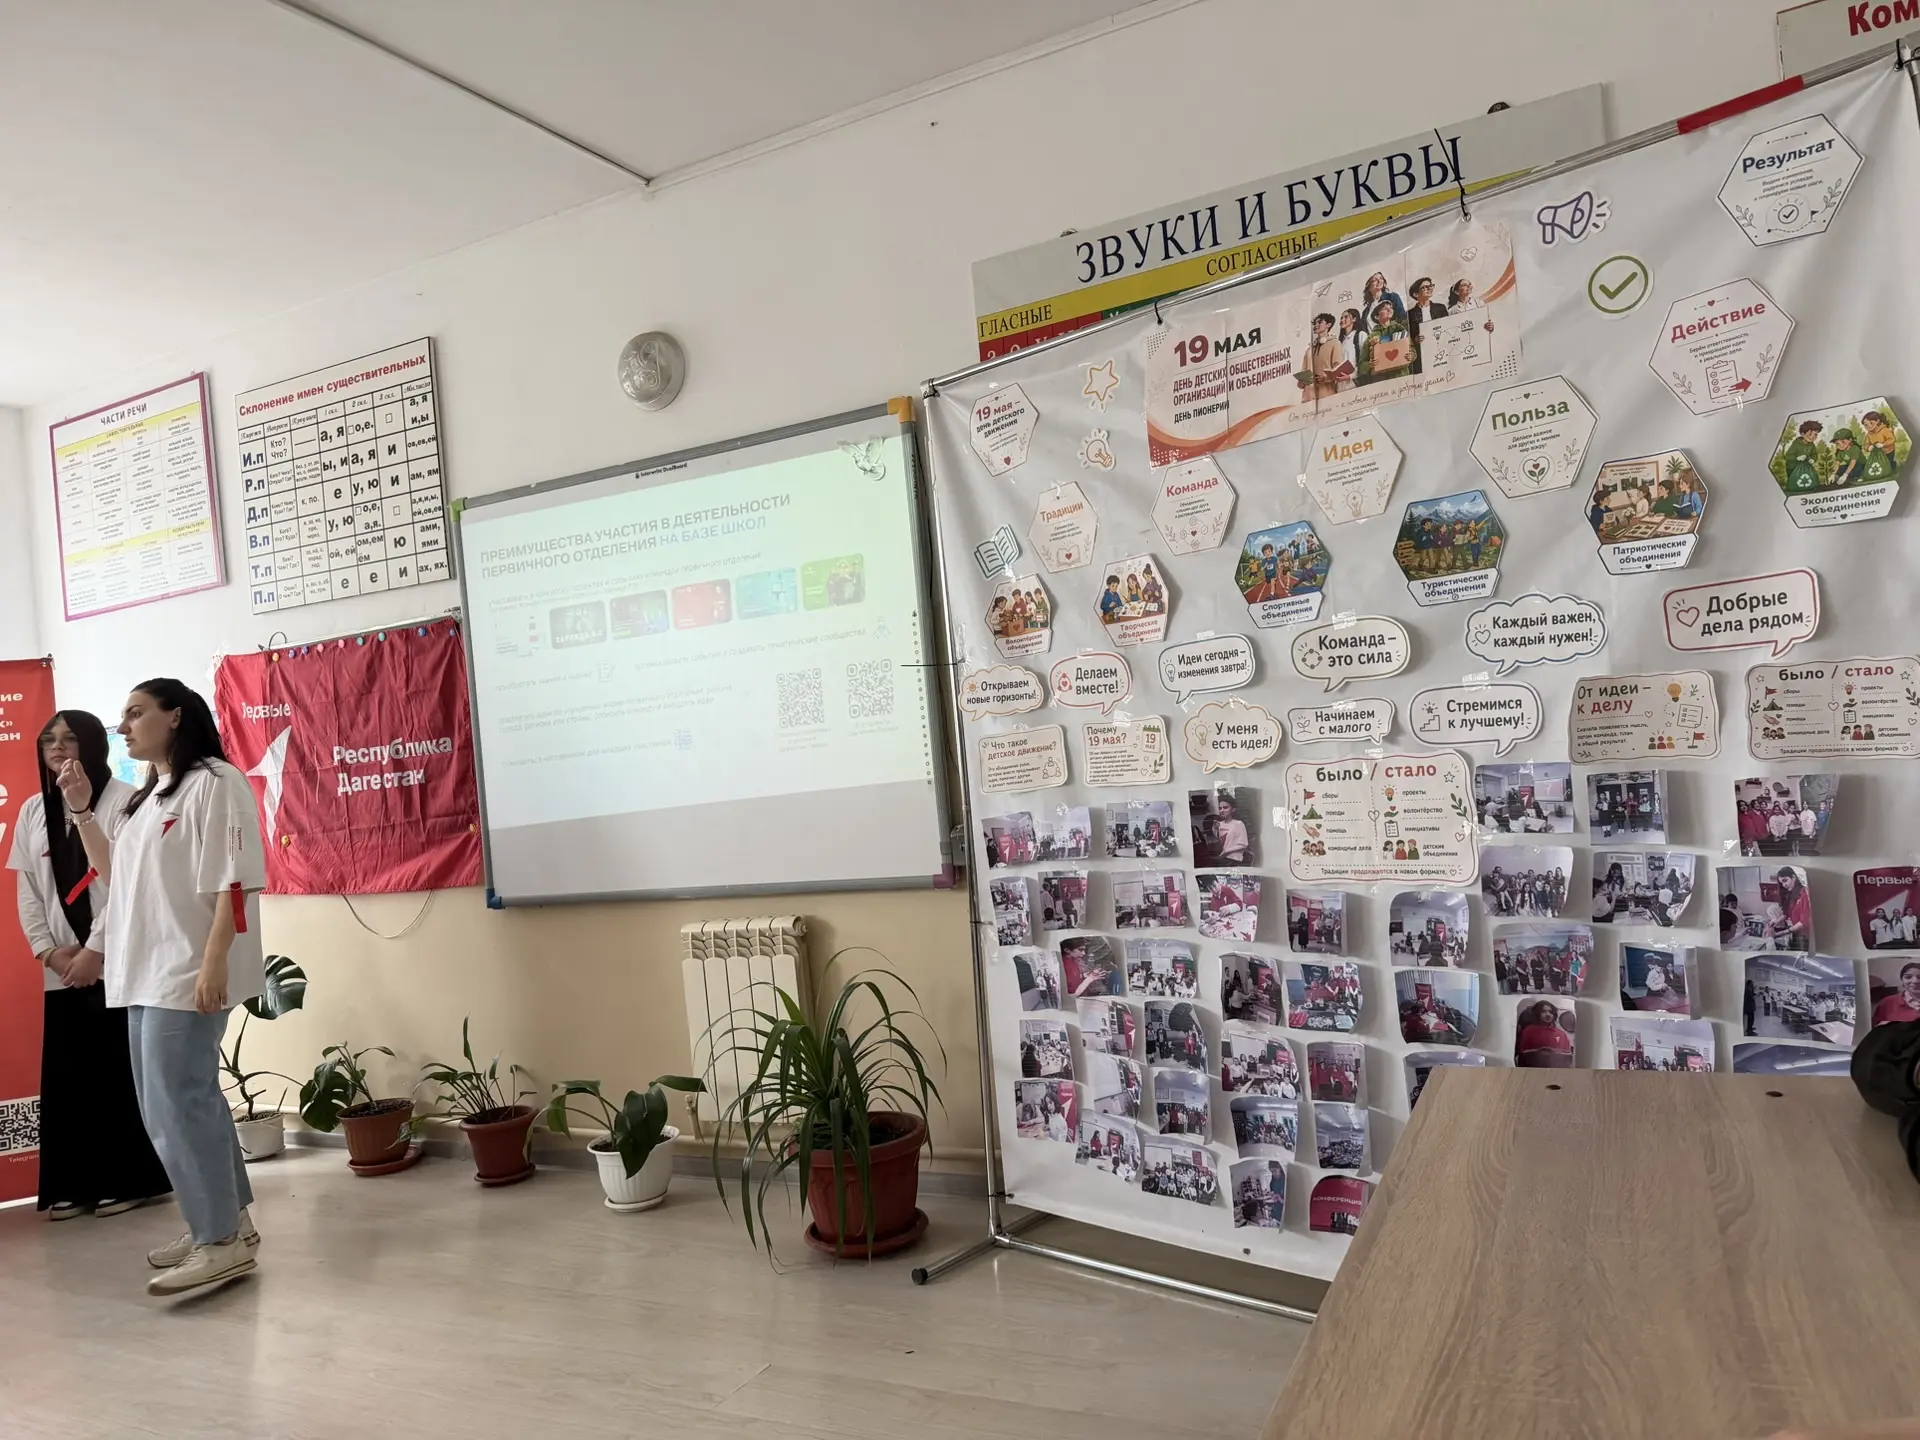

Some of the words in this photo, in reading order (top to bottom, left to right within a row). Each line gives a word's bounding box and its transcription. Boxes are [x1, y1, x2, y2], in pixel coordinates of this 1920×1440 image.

[1742, 138, 1835, 173] Результат
[1076, 211, 1222, 283] ЗВУКИ
[1238, 192, 1270, 239] И
[1286, 136, 1465, 226] БУКВЫ
[1206, 232, 1319, 277] СОГЛАСНЫЕ
[980, 304, 1053, 337] ГЛАСНЫЕ
[1671, 302, 1765, 343] Действие
[1174, 334, 1209, 367] 19
[1214, 327, 1262, 357] МАЯ
[1173, 377, 1193, 394] ДЕНЬ
[1194, 367, 1227, 389] ДЕТСКИХ
[1229, 346, 1291, 377] ОБЩЕСТВЕННЫХ
[239, 394, 294, 416] Склонение
[296, 385, 324, 400] имен
[326, 354, 426, 392] существительных
[1173, 381, 1226, 406] ОРГАНИЗАЦИЙ
[1228, 379, 1234, 392] И
[1236, 360, 1292, 390] ОБЪЕДИНЕНИЙ
[100, 411, 126, 426] ЧАСТИ
[127, 403, 148, 417] РЕЧИ
[976, 405, 991, 422] 19
[993, 401, 1012, 416] мая
[1174, 412, 1192, 424] ДЕНЬ
[1193, 402, 1230, 418] ПИОНЕРИИ
[1492, 400, 1570, 430] Польза
[976, 421, 991, 433] день
[992, 408, 1025, 427] детского
[984, 418, 1018, 439] движения
[337, 426, 345, 437] я
[270, 437, 286, 448] Кто?
[1323, 438, 1374, 462] Идея
[243, 452, 264, 467] И.п
[271, 449, 287, 459] Что?
[245, 478, 265, 493] Р.п
[334, 488, 342, 499] е
[1166, 477, 1218, 497] Команда
[1800, 486, 1886, 506] Экологические
[1040, 502, 1084, 523] Традиции
[1805, 498, 1881, 515] объединения
[247, 507, 268, 523] Д.п
[481, 532, 593, 563] ПРЕИМУЩЕСТВА
[594, 520, 658, 542] УЧАСТИЯ
[661, 517, 670, 529] В
[673, 494, 790, 529] ДЕЯТЕЛЬНОСТИ
[249, 534, 270, 549] В.п
[394, 536, 406, 548] ю
[421, 538, 438, 548] ями
[482, 552, 570, 579] ПЕРВИЧНОГО
[573, 537, 657, 562] ОТДЕЛЕНИЯ
[660, 531, 679, 546] НА
[682, 525, 719, 542] БАЗЕ
[721, 516, 766, 535] ШКОЛ
[1612, 539, 1687, 556] Патриотические
[1619, 551, 1681, 565] объединения
[251, 565, 272, 579] Т.п
[369, 572, 378, 583] е
[341, 578, 349, 589] е
[1420, 573, 1489, 590] Туристические
[253, 590, 275, 605] П.п
[1424, 582, 1486, 598] объединения
[1262, 597, 1310, 612] Спортивные
[1706, 591, 1788, 616] Добрые
[1261, 606, 1313, 620] объединения
[1492, 613, 1548, 630] Каждый
[1551, 611, 1596, 626] важен,
[1119, 619, 1158, 632] Творческие
[1701, 619, 1744, 637] дела
[1749, 612, 1804, 633] рядом
[1117, 626, 1161, 640] объединения
[1493, 632, 1545, 648] каждый
[1549, 628, 1593, 646] нужен!
[1318, 633, 1385, 650] Команда
[1177, 654, 1202, 666] Идеи
[1204, 648, 1239, 663] сегодня
[1327, 655, 1353, 668] это
[1358, 651, 1392, 664] сила
[1075, 667, 1118, 682] Делаем
[1177, 665, 1219, 679] изменения
[1220, 660, 1247, 673] завтра!
[1779, 669, 1824, 681] было
[1845, 665, 1894, 677] стало
[981, 680, 1029, 692] Открываем
[1075, 680, 1119, 695] вместе!
[1577, 686, 1593, 700] От
[1599, 684, 1639, 697] идеи
[966, 696, 991, 704] новые
[993, 690, 1036, 703] горизонты!
[1446, 698, 1522, 715] Стремимся
[1577, 704, 1585, 714] к
[1591, 699, 1633, 715] делу
[1315, 709, 1375, 723] Начинаем
[1448, 719, 1456, 729] к
[1459, 712, 1525, 731] лучшему!
[1086, 726, 1117, 735] Почему
[1215, 722, 1224, 735] У
[1227, 725, 1258, 735] меня
[1318, 726, 1325, 735] с
[1328, 723, 1372, 734] малого
[991, 741, 1005, 750] Что
[1007, 739, 1028, 748] такое
[1088, 736, 1099, 746] 19
[1102, 733, 1127, 745] мая?
[1145, 733, 1156, 744] 19
[1212, 739, 1237, 750] есть
[1240, 736, 1273, 750] идея!
[333, 737, 453, 765] Республика
[988, 750, 1016, 761] детское
[1017, 741, 1057, 756] движение?
[1316, 767, 1363, 782] было
[1385, 764, 1437, 778] стало
[337, 768, 425, 797] Дагестан
[1402, 789, 1426, 797] проекты
[1403, 806, 1443, 814] волонтёрство
[1405, 825, 1440, 833] инициативы
[1856, 874, 1913, 887] Первые
